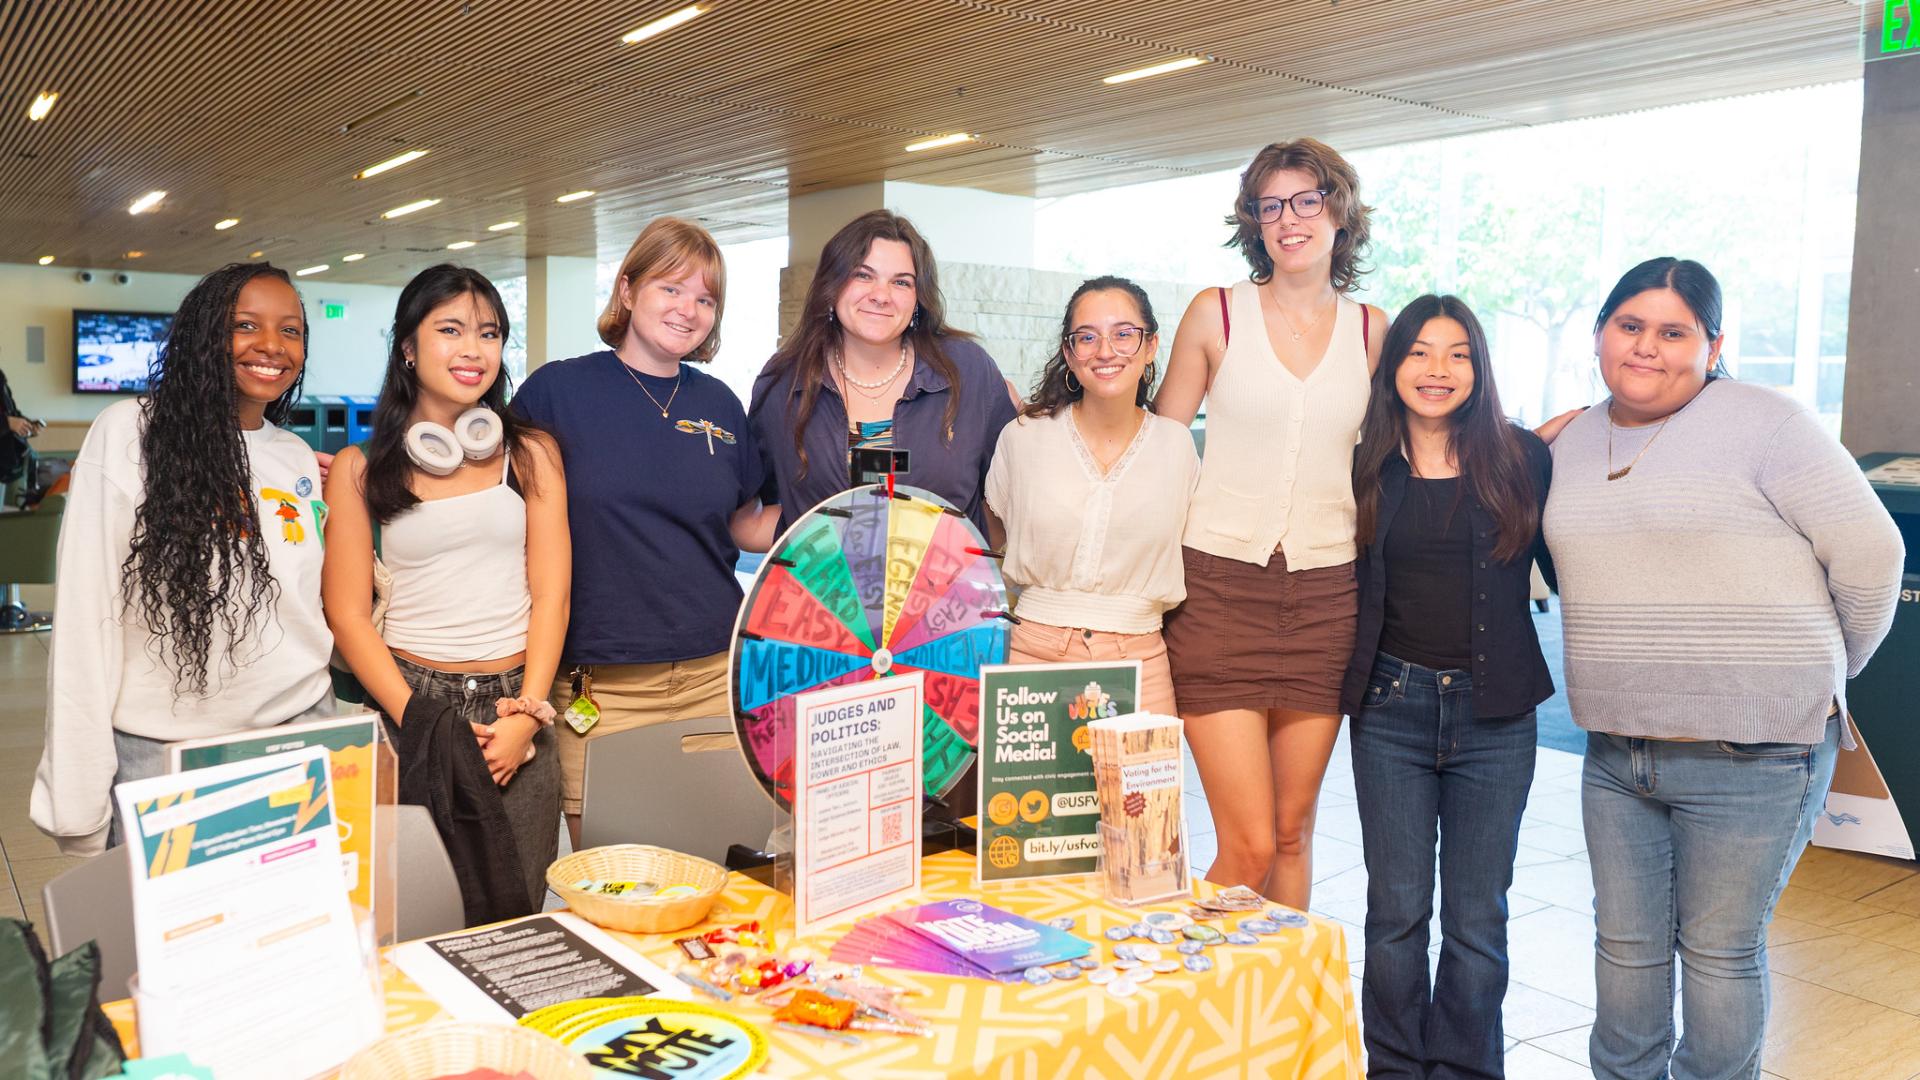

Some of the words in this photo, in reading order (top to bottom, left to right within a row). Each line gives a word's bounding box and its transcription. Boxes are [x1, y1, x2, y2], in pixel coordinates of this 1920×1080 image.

[758, 574, 850, 647] EASY
[743, 641, 851, 706] MEDIUM
[996, 686, 1058, 706] Follow
[811, 704, 864, 727] JUDGES
[868, 698, 896, 714] AND
[996, 706, 1019, 725] Us
[1021, 711, 1045, 724] on
[811, 719, 881, 746] POLITICS:
[996, 723, 1049, 744] Social
[811, 739, 863, 758] NAVIGATING
[865, 736, 879, 746] THE
[811, 749, 869, 770] INTERSECTION
[871, 746, 881, 755] OF
[995, 741, 1057, 763] Media!
[811, 767, 839, 781] POWER
[841, 762, 858, 773] AND
[859, 755, 887, 769] ETHICS
[1004, 774, 1032, 782] connected
[1057, 771, 1089, 779] engagement
[1123, 767, 1149, 778] Voting
[1151, 765, 1162, 774] for
[1164, 763, 1177, 772] the
[1126, 775, 1175, 790] Environment
[584, 1017, 675, 1070] MY
[611, 1029, 736, 1080] VOTE
